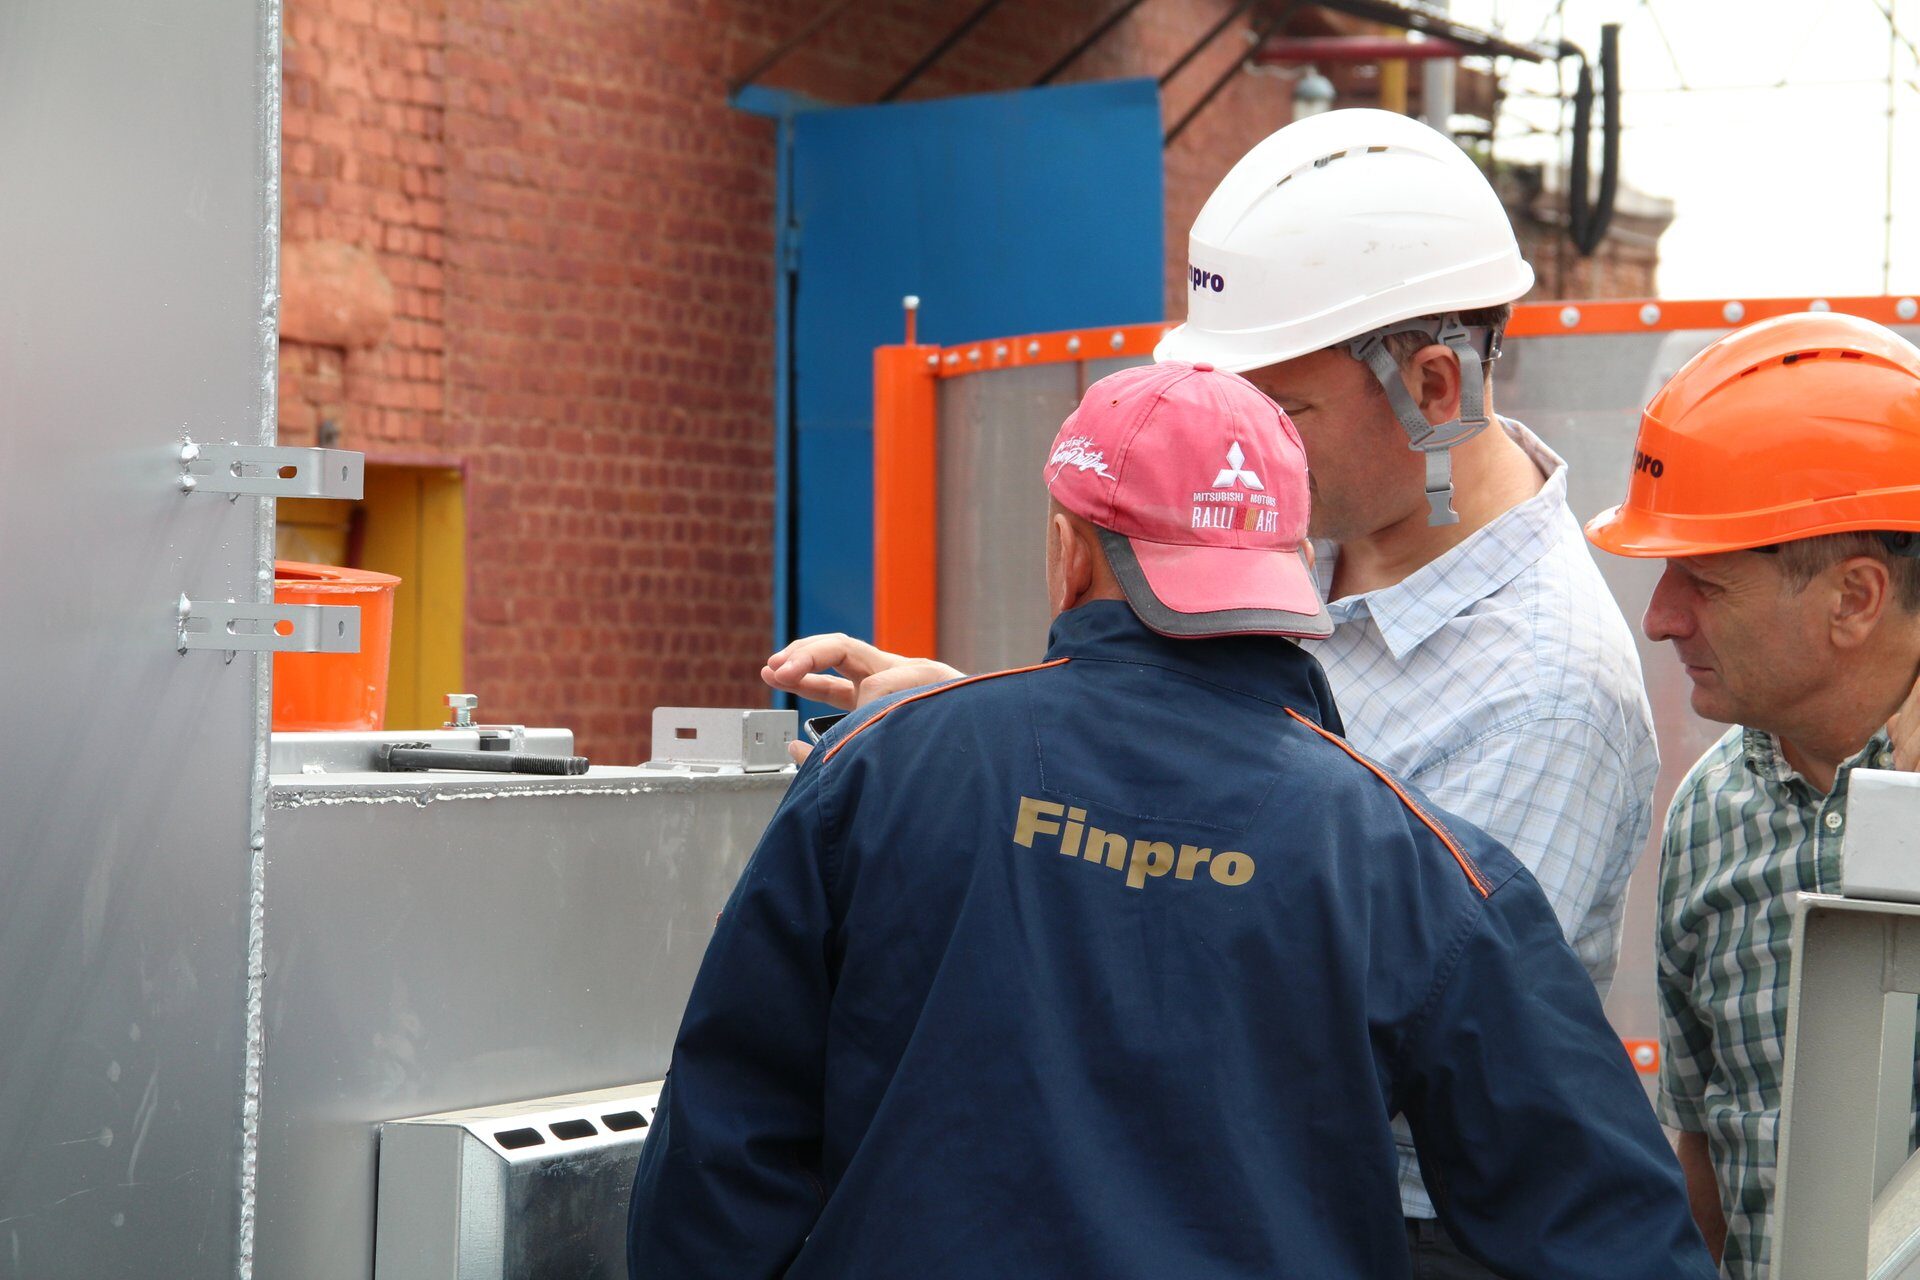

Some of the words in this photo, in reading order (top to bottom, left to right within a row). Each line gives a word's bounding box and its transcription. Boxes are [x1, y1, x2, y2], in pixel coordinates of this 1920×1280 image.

[1193, 491, 1244, 502] MITSUBISHI
[1250, 493, 1276, 507] MOTORS
[1013, 796, 1256, 889] Finpro
